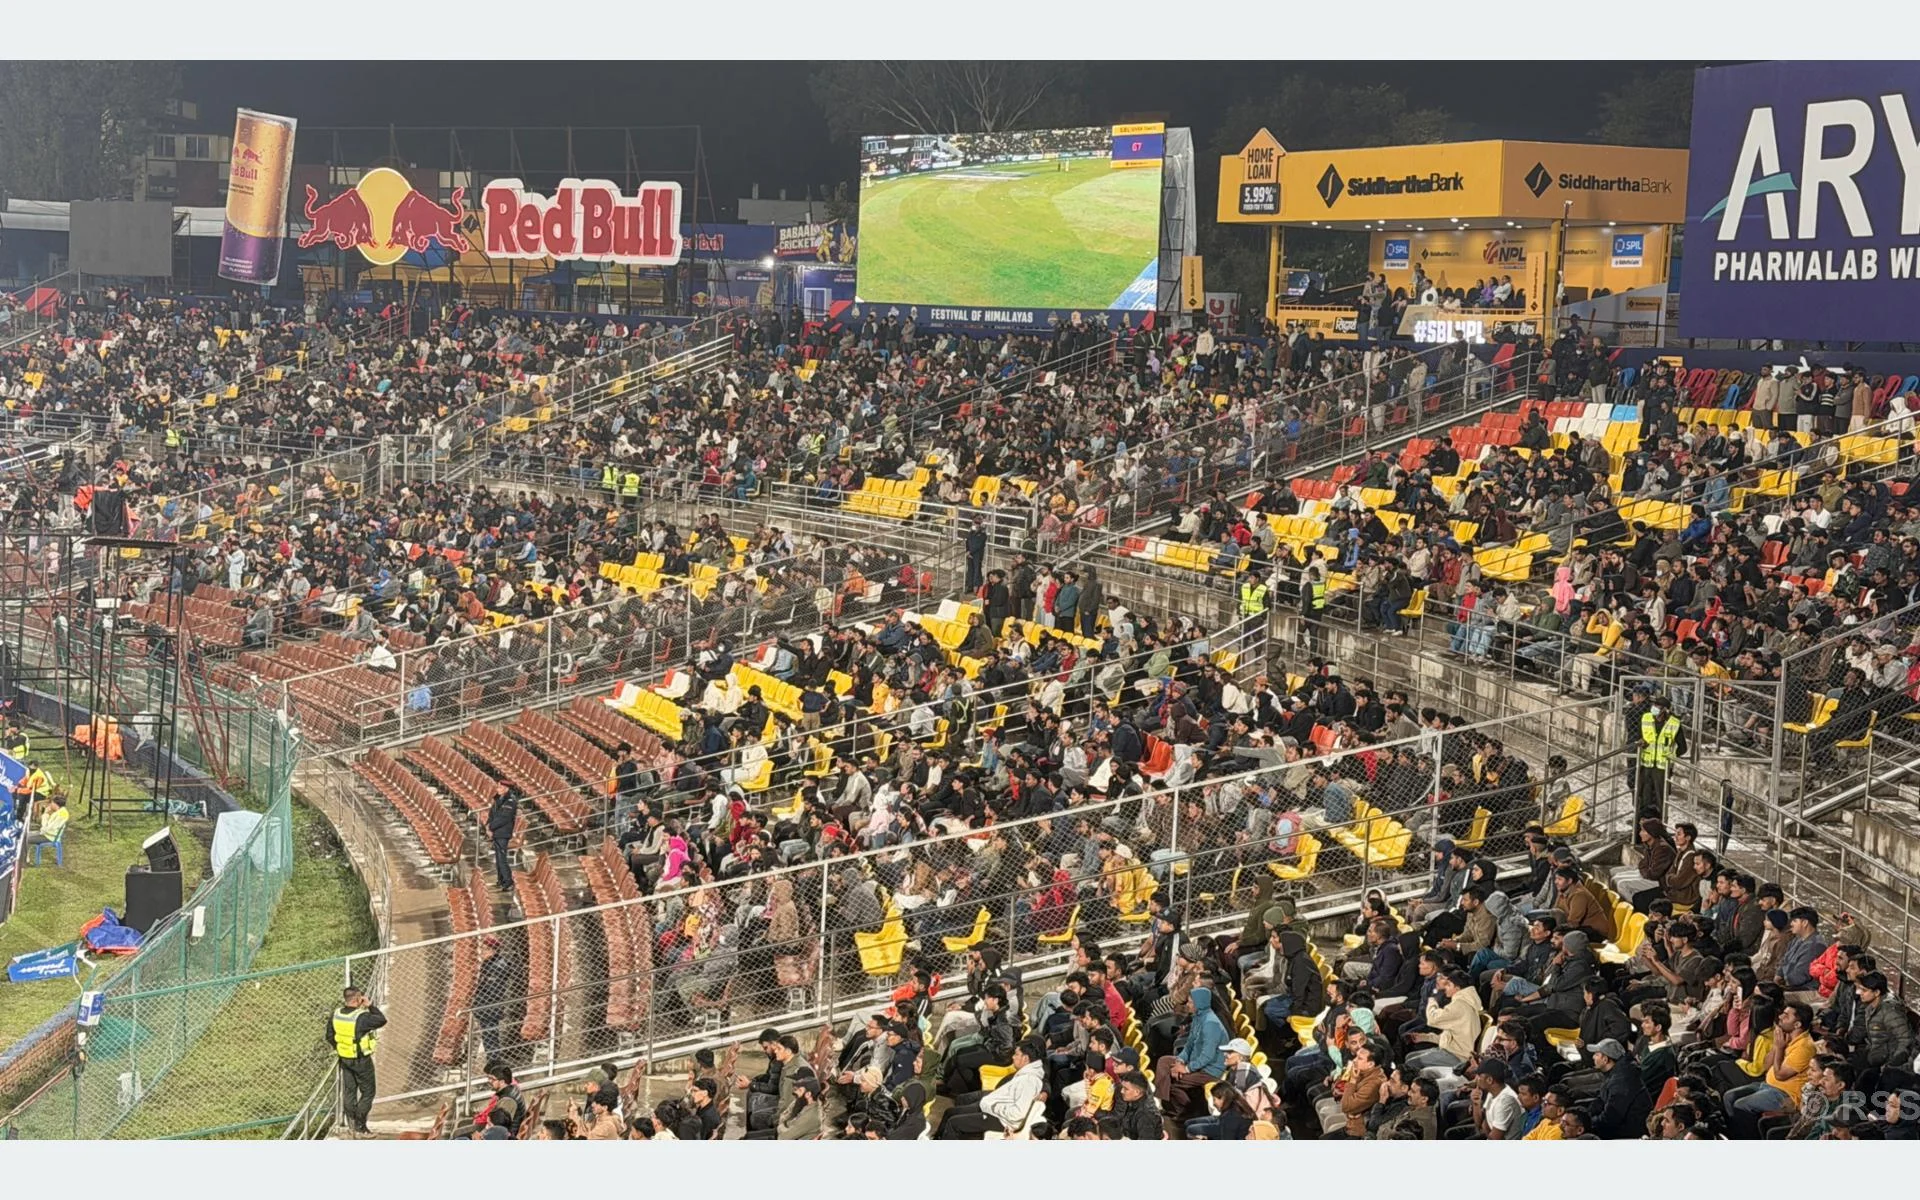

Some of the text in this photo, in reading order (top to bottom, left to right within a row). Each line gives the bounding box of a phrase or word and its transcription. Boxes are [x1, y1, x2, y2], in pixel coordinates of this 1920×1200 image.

[1247, 148, 1275, 164] HOME
[240, 166, 258, 180] Bull
[1247, 164, 1273, 180] LOAN
[1348, 172, 1464, 196] SiddharthaBank
[1558, 174, 1672, 194] SiddharthaBank
[486, 187, 675, 257] Red Bull
[780, 237, 816, 250] CRICKET
[1626, 240, 1642, 250] SPIL
[1499, 247, 1527, 262] NPL
[1714, 247, 1920, 281] PHARMALAB W
[931, 308, 1034, 323] FESTIVAL OF HIMALAYAS
